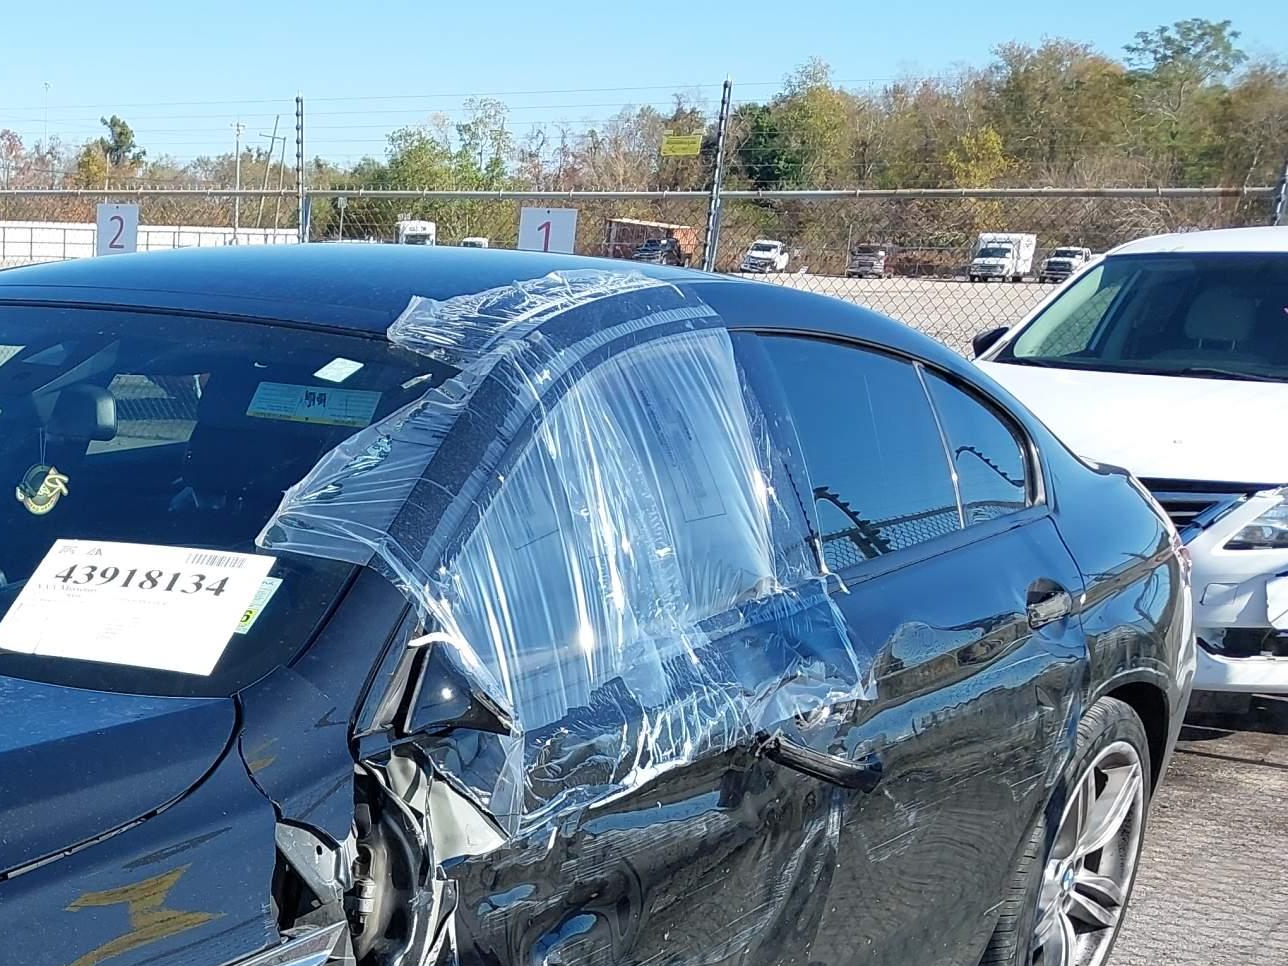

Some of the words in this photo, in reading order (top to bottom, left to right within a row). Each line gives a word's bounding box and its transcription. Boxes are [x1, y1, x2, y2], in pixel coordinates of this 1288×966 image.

[109, 215, 125, 249] 2
[537, 221, 551, 253] 1
[54, 563, 230, 597] 43918134
